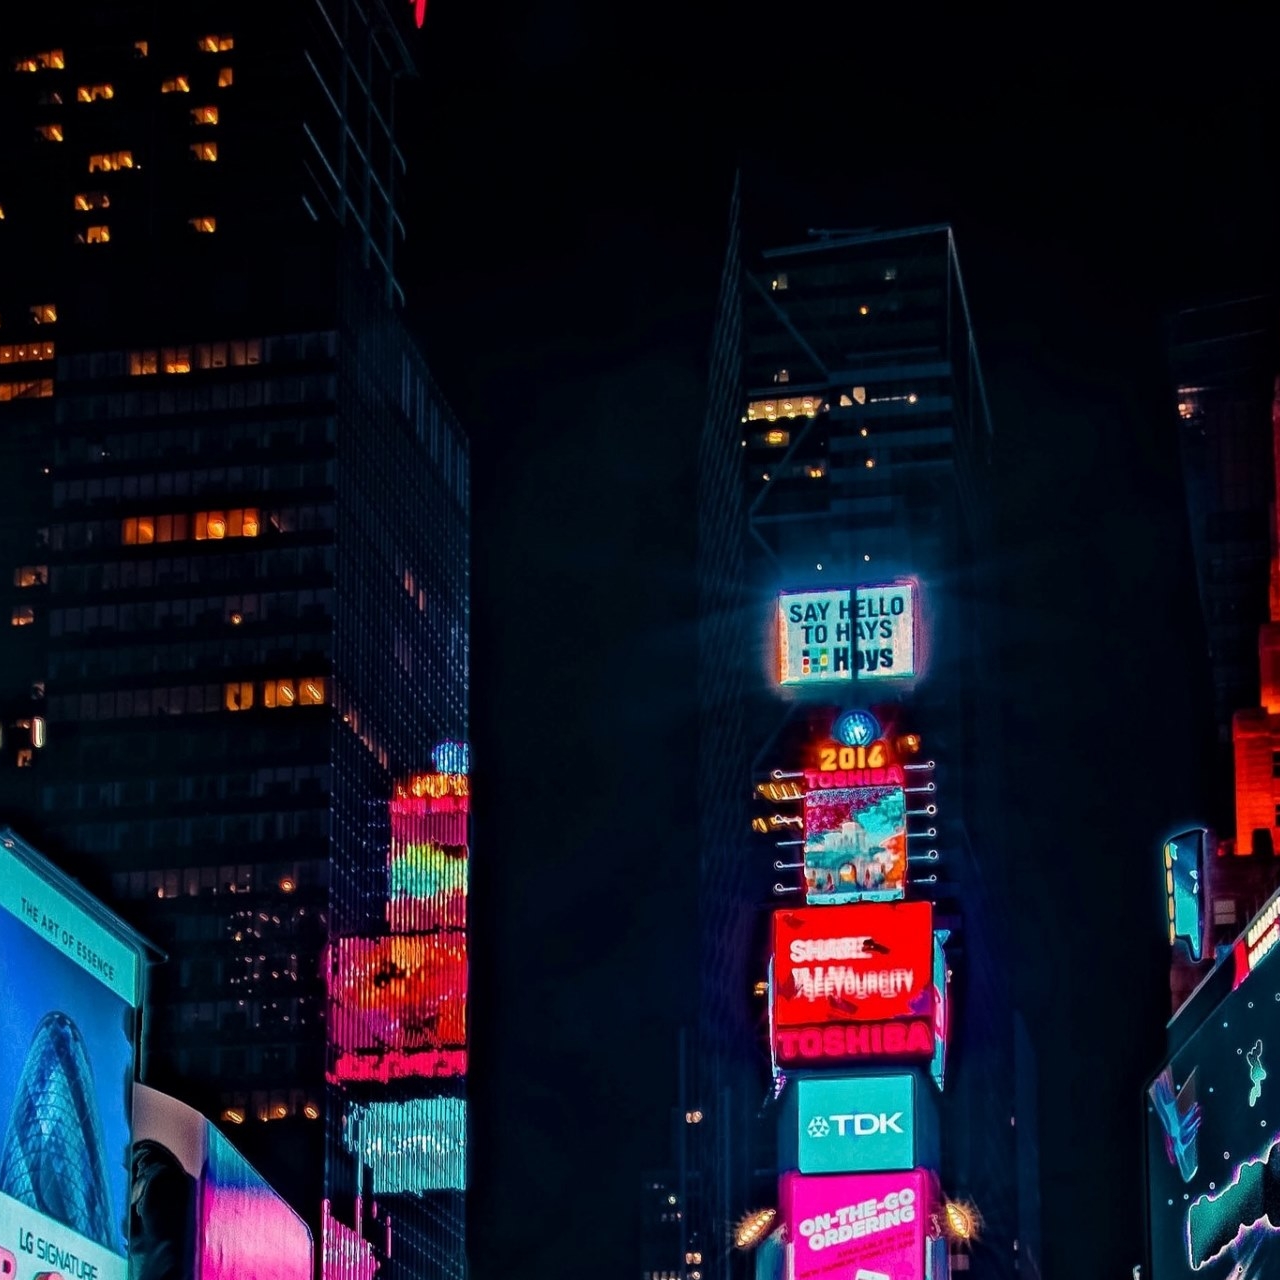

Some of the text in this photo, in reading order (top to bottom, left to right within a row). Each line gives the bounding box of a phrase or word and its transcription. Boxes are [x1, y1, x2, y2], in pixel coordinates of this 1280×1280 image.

[789, 596, 904, 623] SAY HELLO
[801, 620, 892, 644] TO HAYS
[820, 745, 885, 771] 2016
[804, 764, 905, 788] TOSHIBA
[21, 898, 116, 982] THE ART OF ESSENCE
[776, 1023, 932, 1059] TOSHIBA
[830, 1112, 904, 1138] TDK
[799, 1188, 915, 1236] ON-THE-GO
[19, 1227, 34, 1254] LG
[809, 1205, 915, 1251] ORDERING
